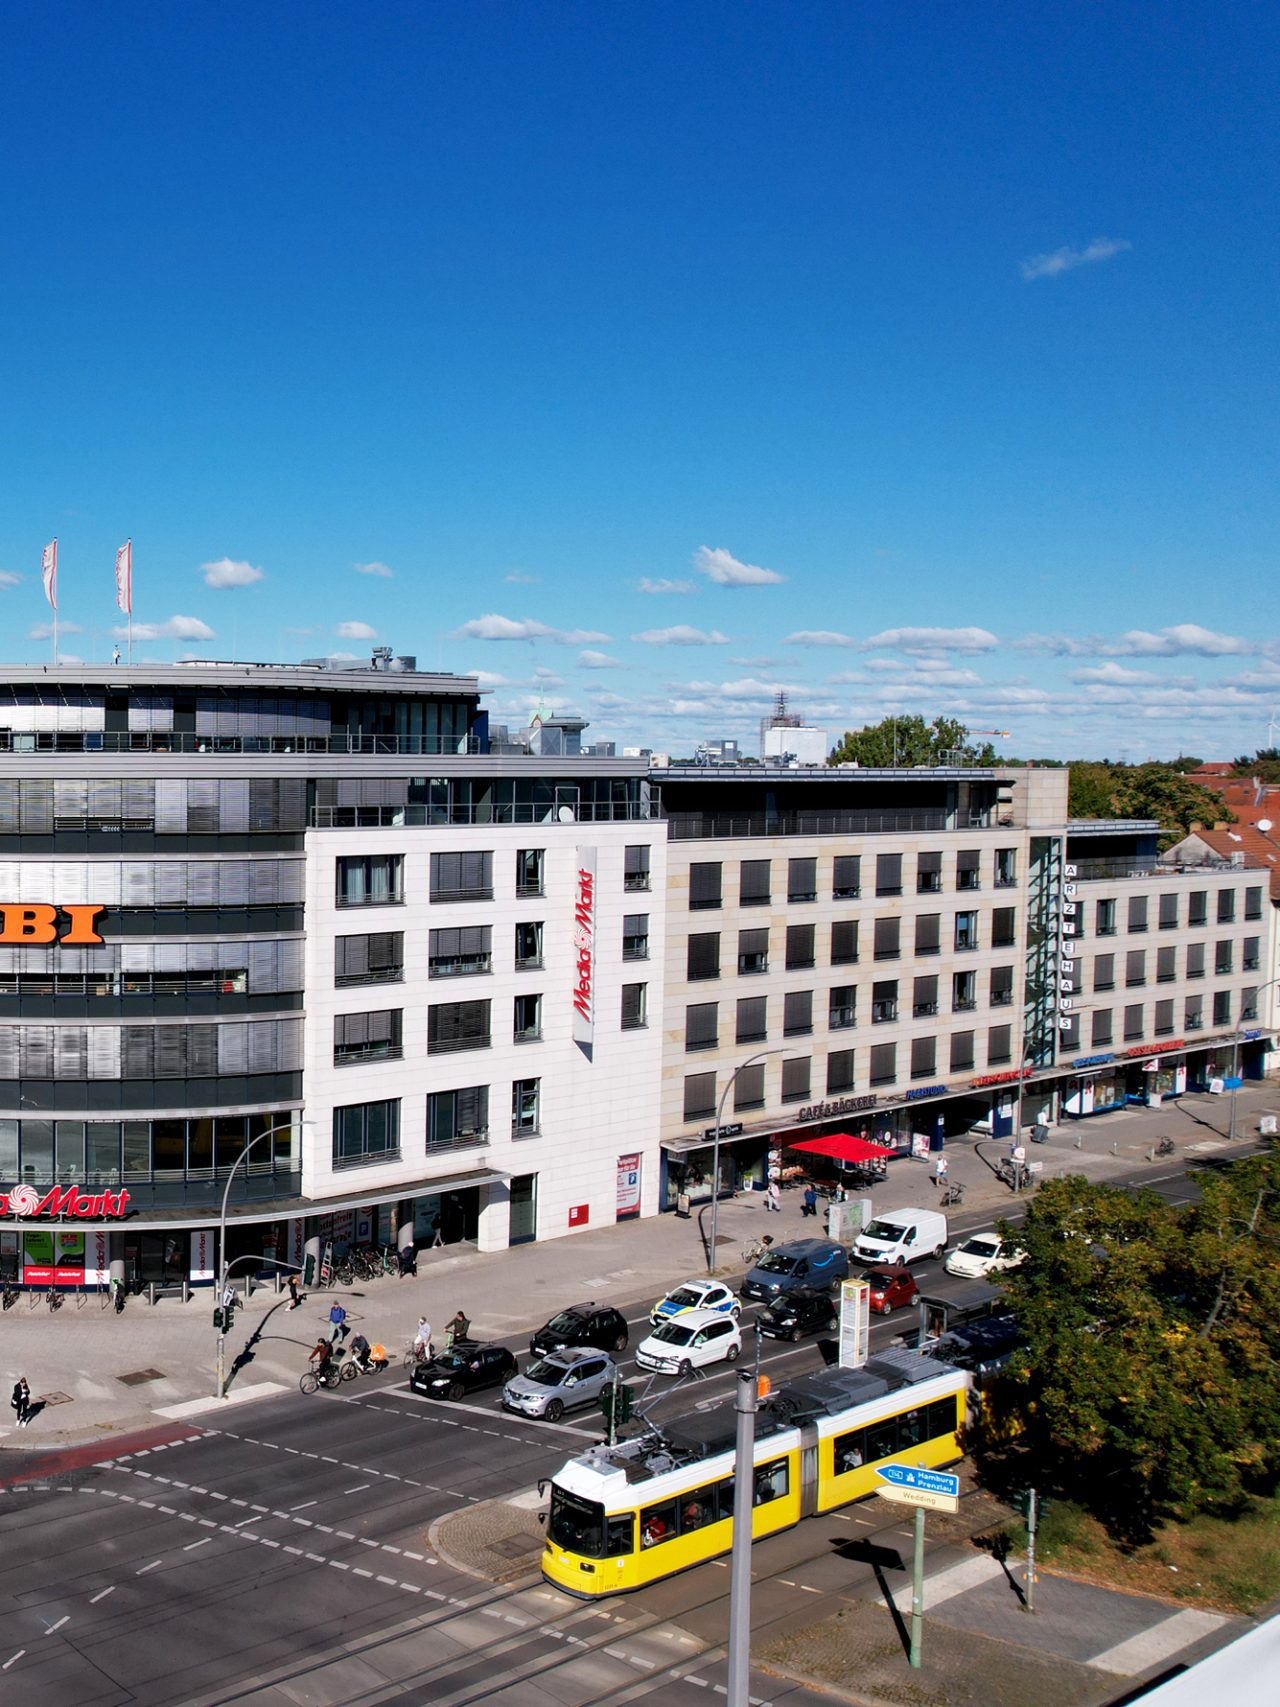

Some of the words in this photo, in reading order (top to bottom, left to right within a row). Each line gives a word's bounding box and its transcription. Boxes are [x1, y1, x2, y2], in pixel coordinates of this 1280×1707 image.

[575, 868, 593, 935] Markt
[573, 947, 592, 1023] Media
[799, 1100, 824, 1120] CAFÉ
[831, 1094, 878, 1115] BÄCKEREI
[32, 1184, 131, 1217] Markt
[917, 1472, 954, 1486] Hamburg
[917, 1480, 952, 1493] Prenzlau
[903, 1492, 937, 1506] Wedding
